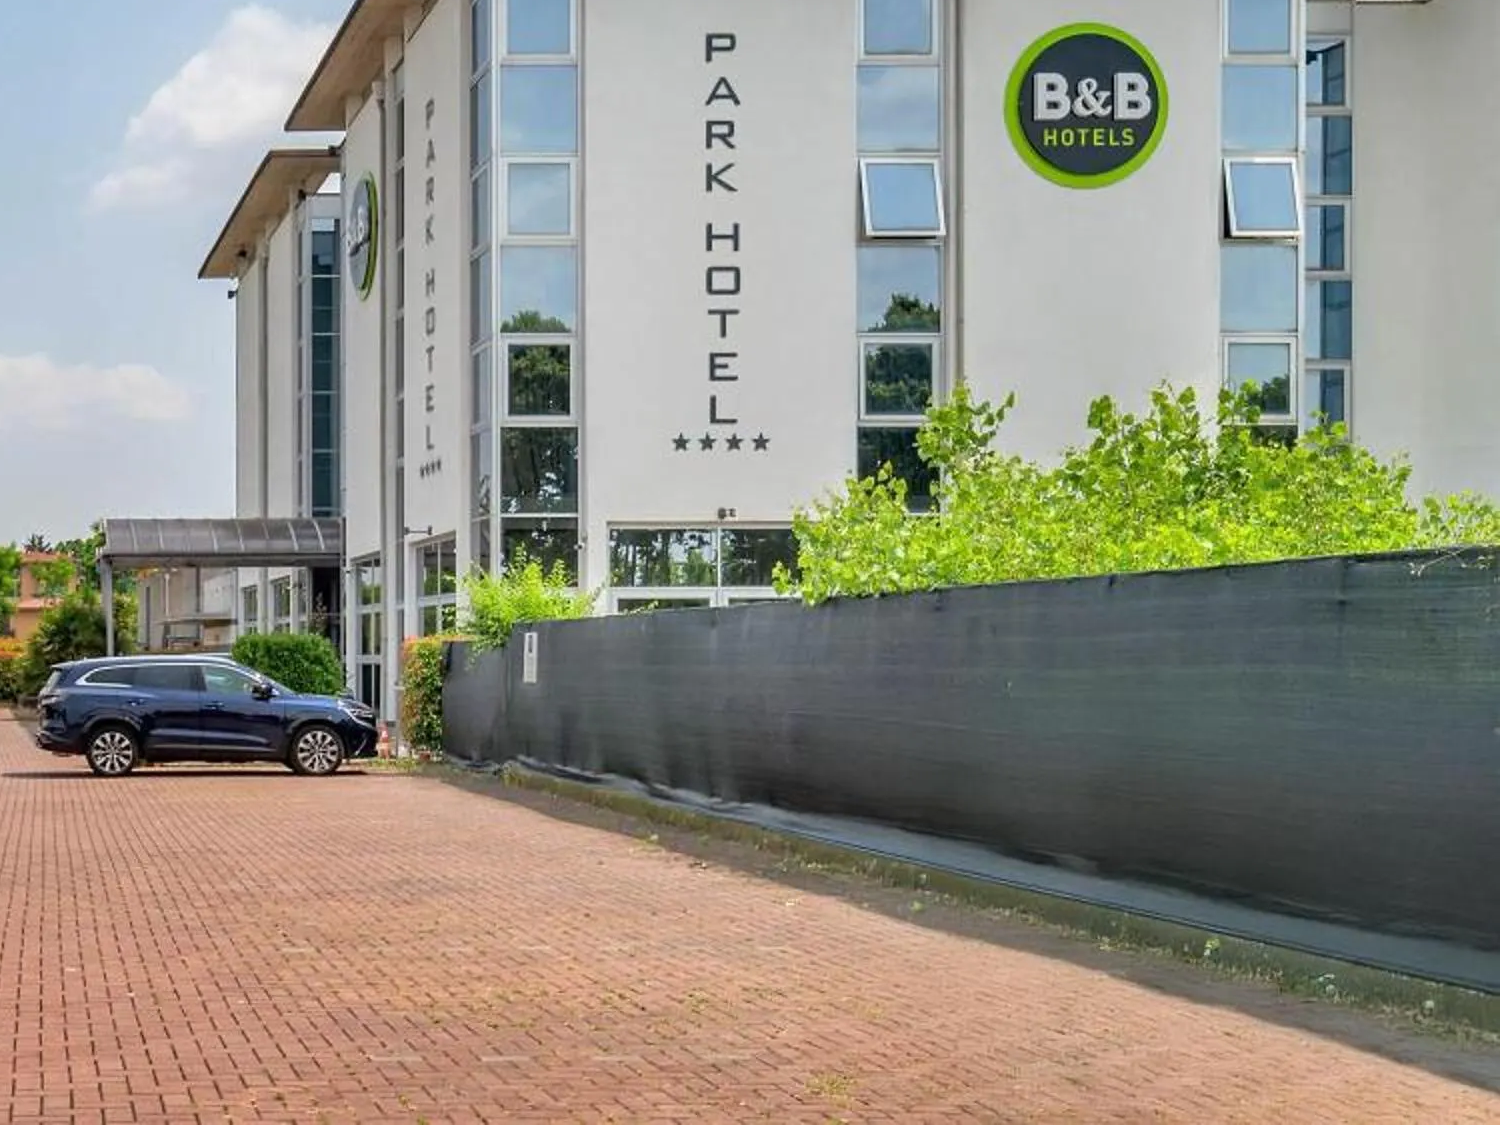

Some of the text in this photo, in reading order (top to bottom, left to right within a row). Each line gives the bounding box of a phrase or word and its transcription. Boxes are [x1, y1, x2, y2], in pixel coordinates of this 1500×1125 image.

[1032, 72, 1152, 122] B&B
[1043, 128, 1135, 147] HOTELS
[425, 98, 436, 451] PARK HOTEL
[705, 33, 741, 425] PARK HOTEL
